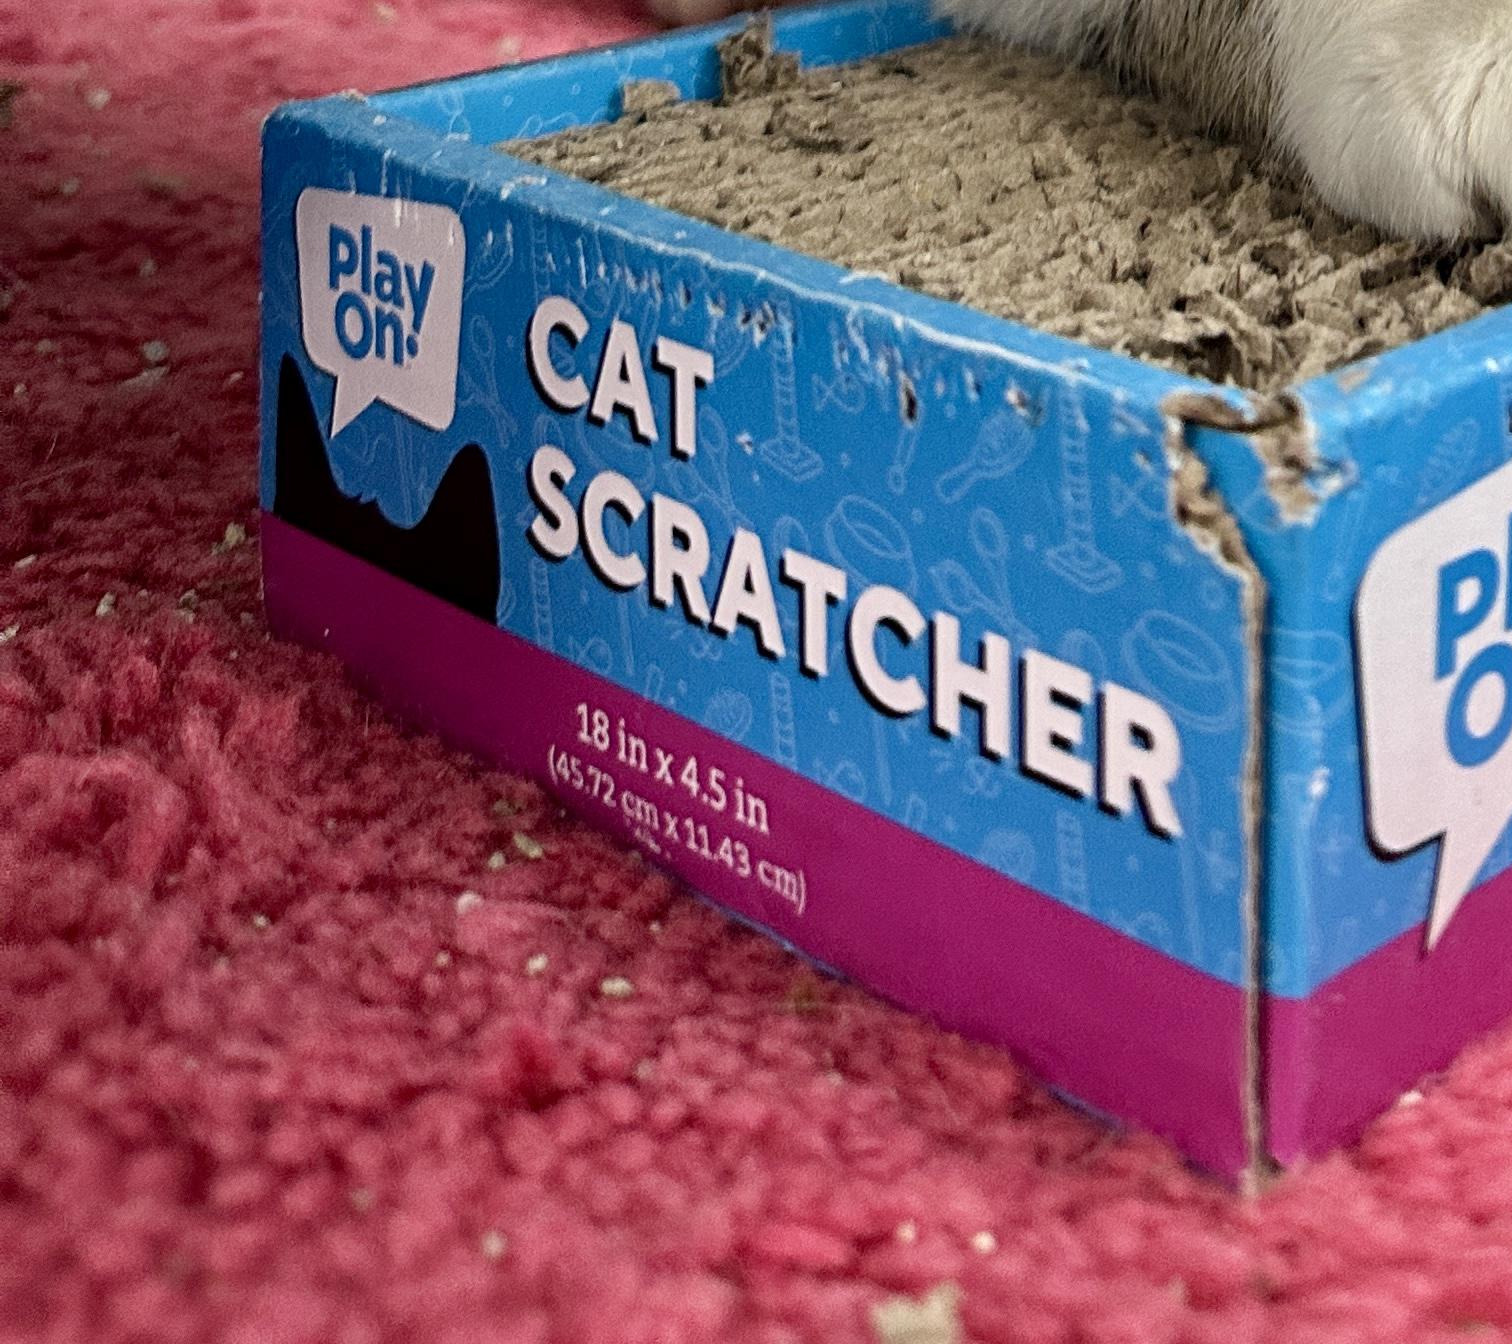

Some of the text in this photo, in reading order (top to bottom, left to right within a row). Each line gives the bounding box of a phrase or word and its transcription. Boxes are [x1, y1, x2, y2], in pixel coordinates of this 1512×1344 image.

[329, 223, 435, 334] Play
[334, 290, 419, 368] On!
[529, 296, 714, 458] CAT
[529, 445, 1183, 839] SCRATCHER
[549, 744, 617, 809] (45.72
[620, 790, 660, 831] cm
[663, 811, 680, 842] x
[684, 818, 751, 878] 11.43
[757, 861, 807, 915] cm)
[576, 703, 770, 835] 18 in x 4.5 in
